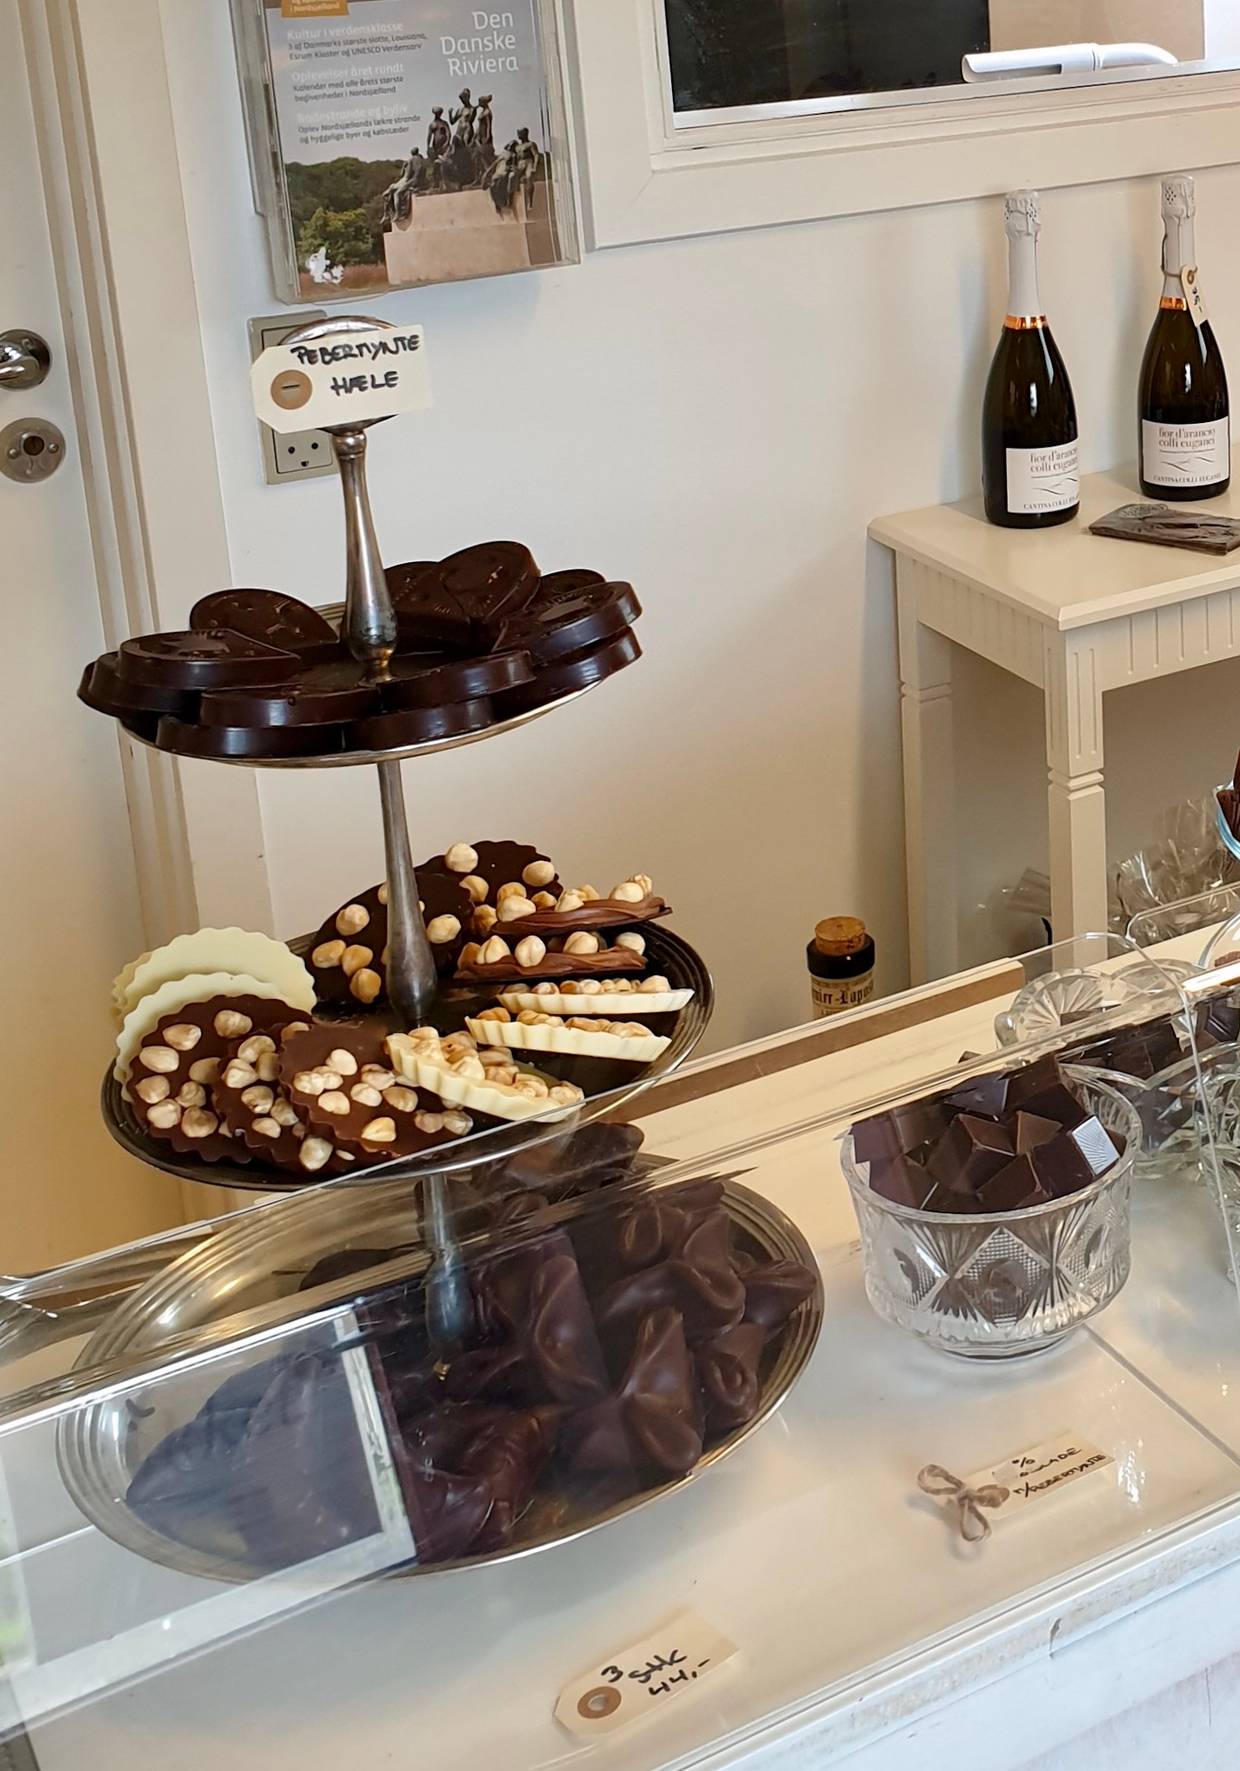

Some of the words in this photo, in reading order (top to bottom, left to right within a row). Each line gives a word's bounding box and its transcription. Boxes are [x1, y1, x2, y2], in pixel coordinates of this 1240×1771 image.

[472, 11, 513, 30] Den
[287, 29, 320, 40] Kultur
[329, 22, 403, 37] verdensklasse
[289, 51, 313, 60] Esrum
[314, 49, 340, 59] Kloster
[341, 50, 351, 59] og
[351, 46, 381, 56] UNESCO
[382, 42, 423, 53] Verdensarv
[303, 40, 341, 50] Danmarks
[440, 31, 516, 55] Danske
[291, 69, 348, 83] Oplevelser
[376, 63, 404, 74] rundt
[447, 54, 519, 77] Riviera
[293, 82, 327, 92] Kalender
[328, 80, 344, 90] med
[290, 334, 421, 364] PEBERMYNTE
[330, 371, 400, 396] HÆLE
[600, 1665, 624, 1684] 3
